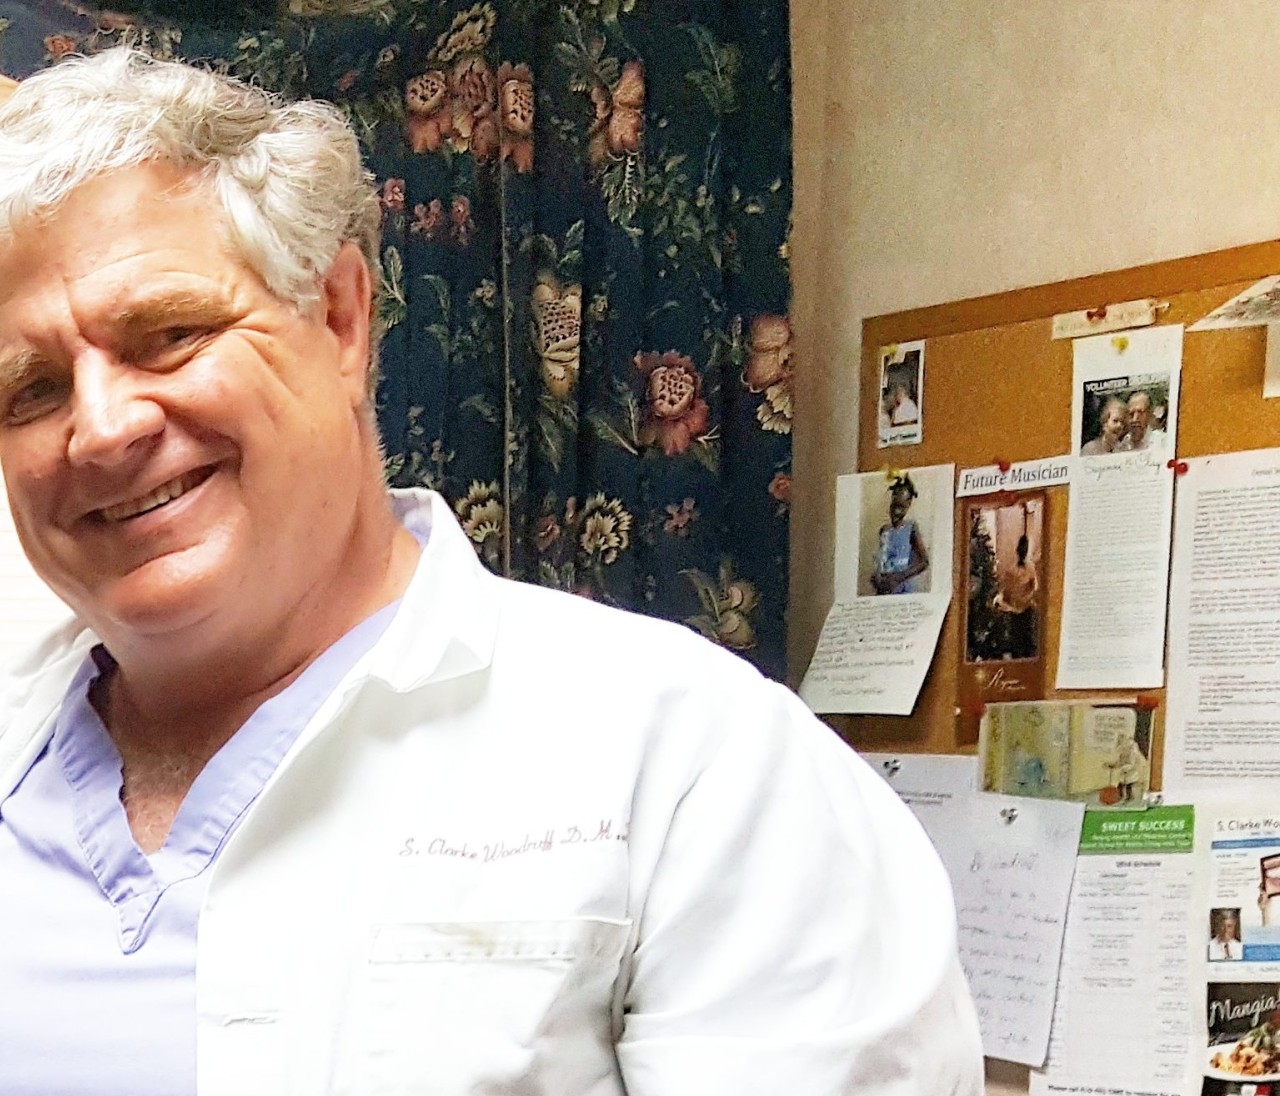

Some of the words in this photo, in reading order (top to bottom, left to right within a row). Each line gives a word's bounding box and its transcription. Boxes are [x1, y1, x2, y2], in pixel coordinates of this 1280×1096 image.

[963, 472, 1007, 490] Future
[1011, 464, 1069, 485] Musician
[1102, 820, 1136, 832] SWEET
[1138, 819, 1186, 831] SUCCESS
[1228, 819, 1261, 831] Clarke
[1263, 818, 1280, 829] Wo
[399, 837, 420, 857] S.
[428, 837, 478, 859] Clarke
